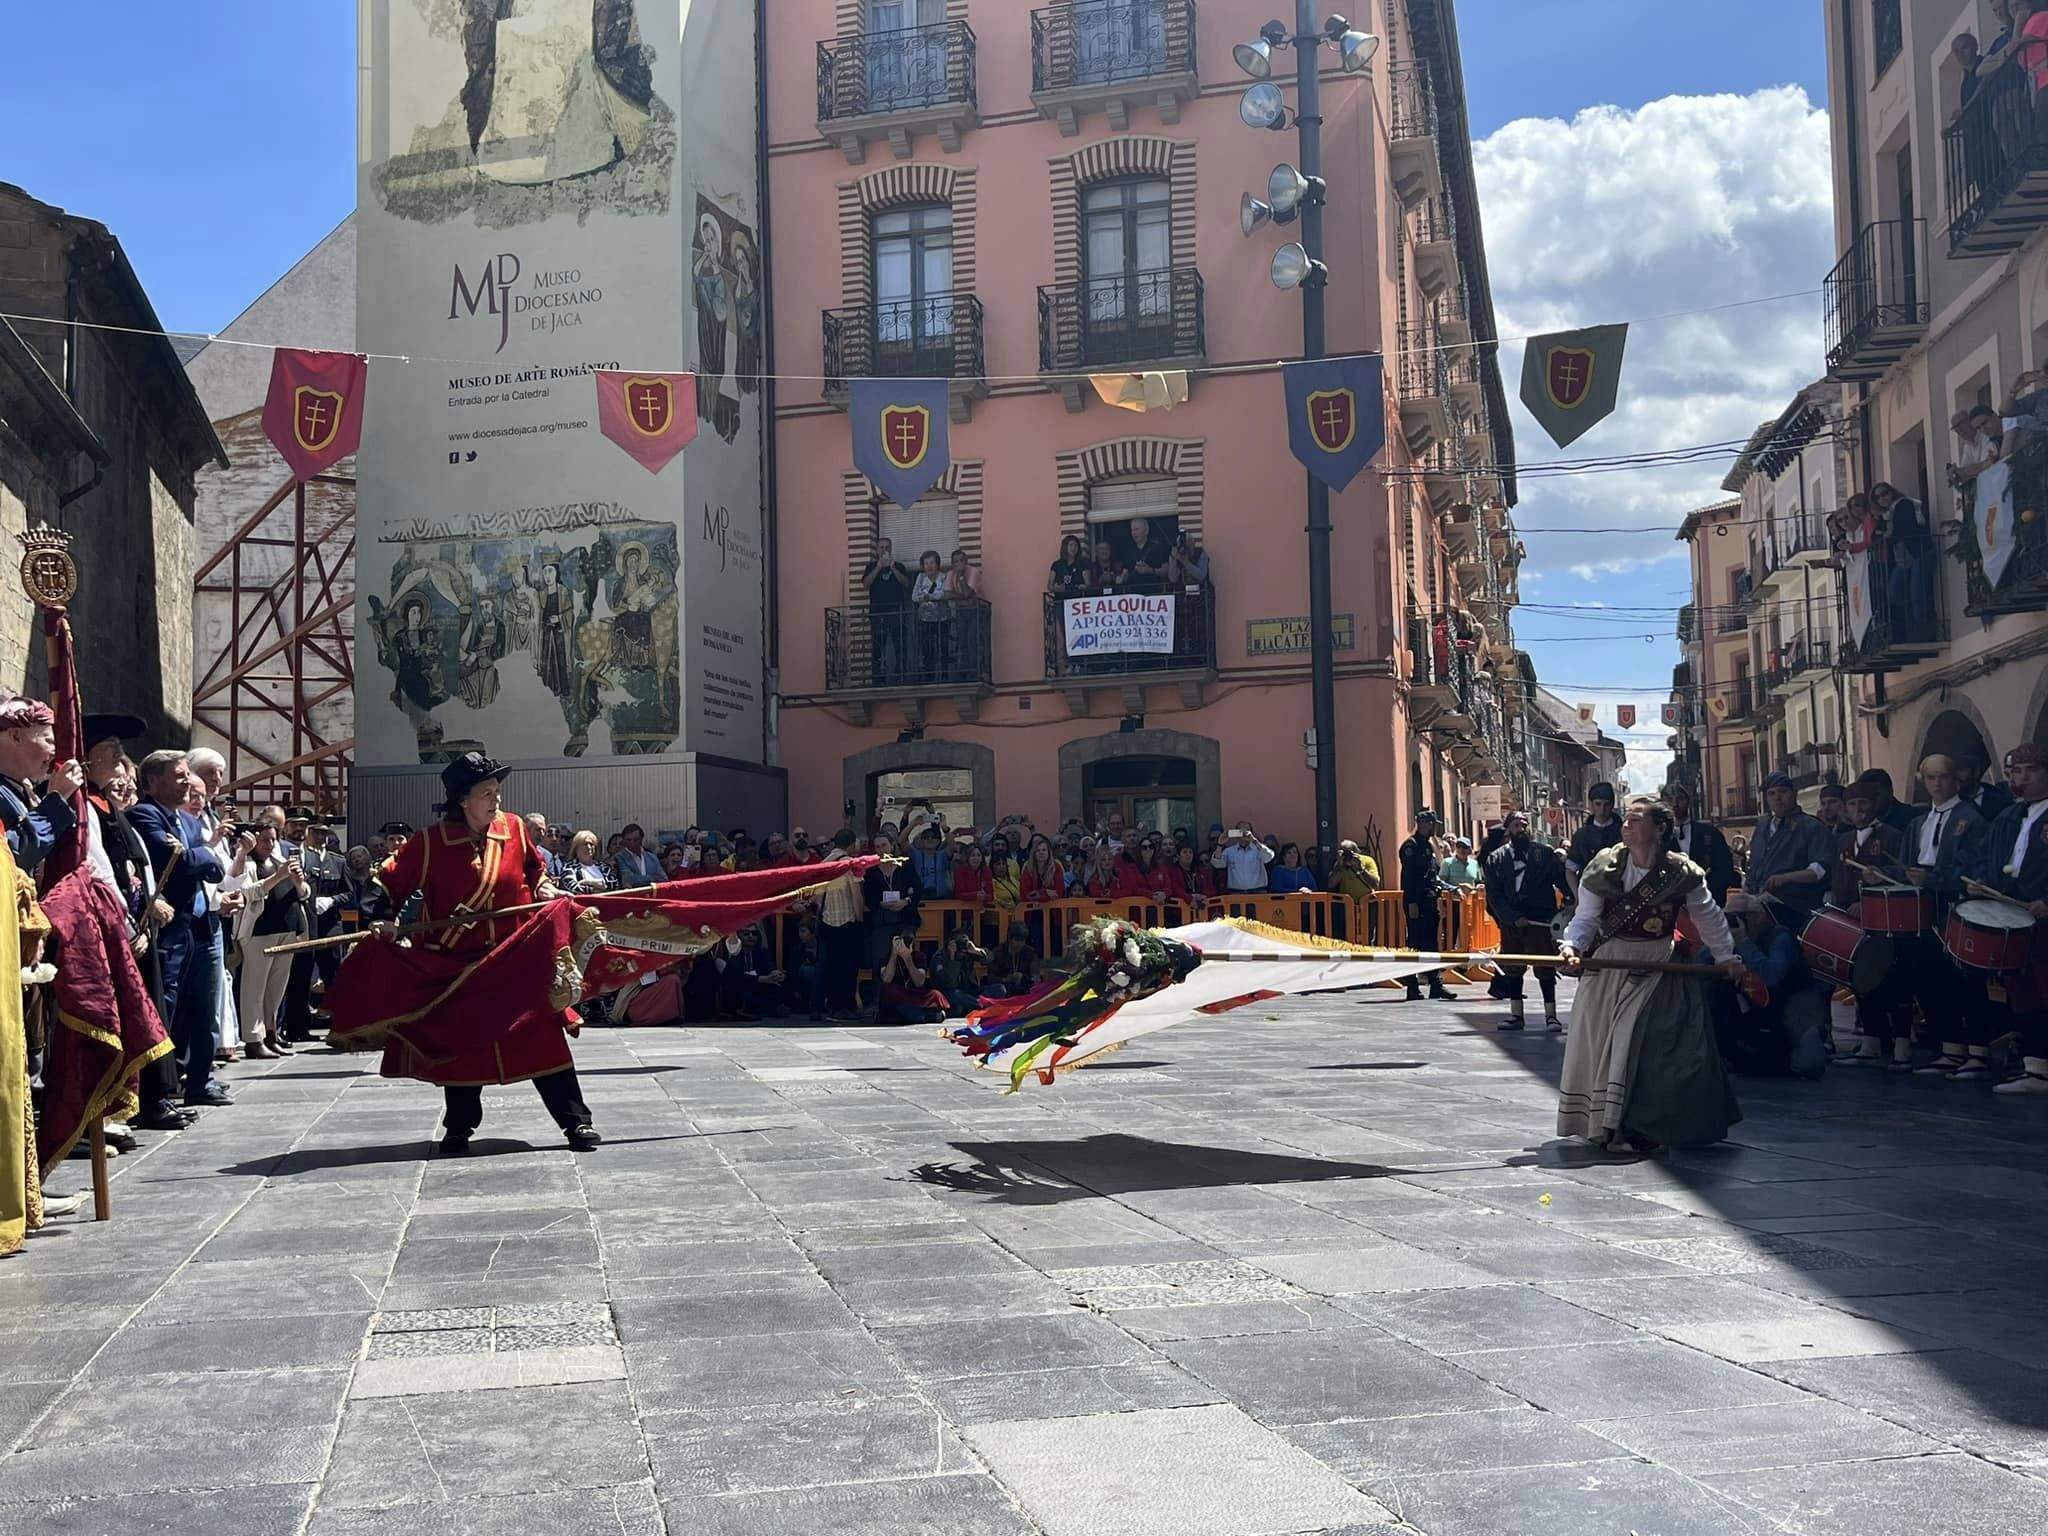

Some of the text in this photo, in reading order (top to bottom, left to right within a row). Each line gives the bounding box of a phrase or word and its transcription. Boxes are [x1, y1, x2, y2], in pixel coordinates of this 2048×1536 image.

[448, 374, 491, 390] MUSEO
[494, 373, 512, 386] DE
[514, 367, 547, 383] ARTE
[448, 388, 550, 408] Entrada por la Catedral
[448, 420, 589, 442] www.diocesisdejaca.org/museo
[1071, 598, 1168, 616] SE ALQUILA
[1072, 614, 1168, 630] APIGABASA
[1281, 622, 1311, 634] PLAZ
[1071, 633, 1098, 650] API
[1099, 627, 1121, 639] 605
[1145, 627, 1168, 639] 336
[641, 940, 673, 953] PRIMI
